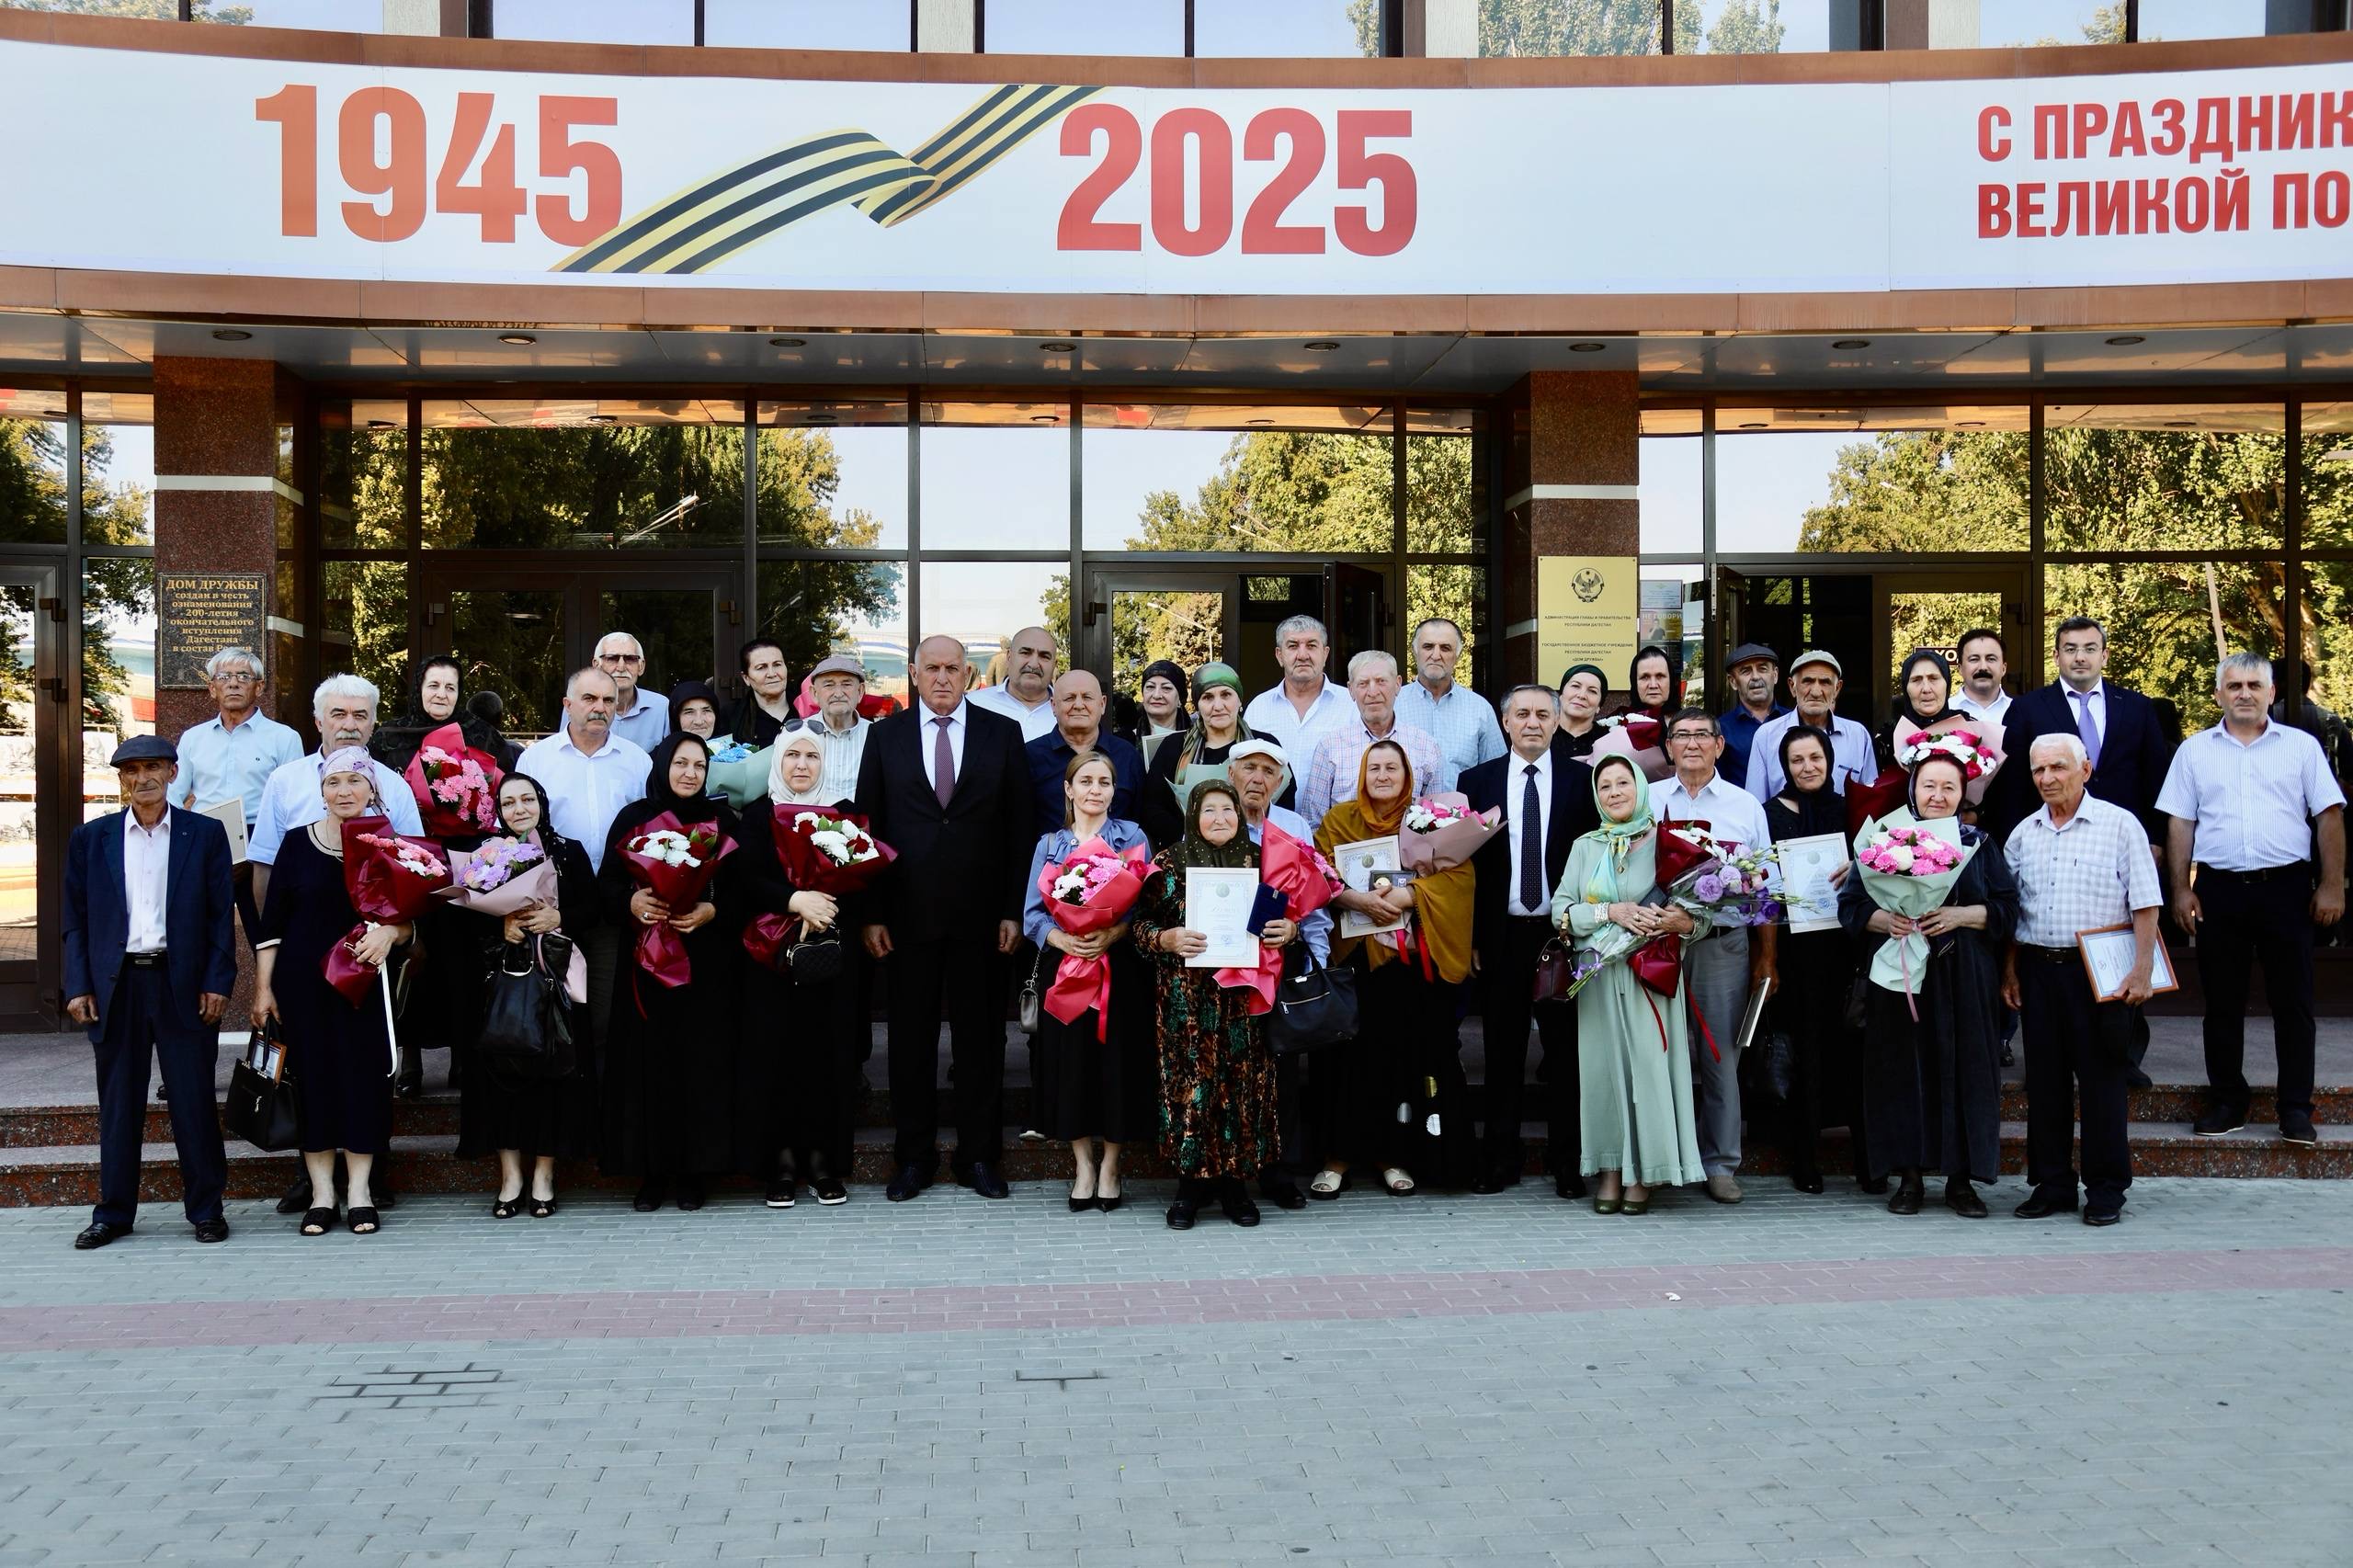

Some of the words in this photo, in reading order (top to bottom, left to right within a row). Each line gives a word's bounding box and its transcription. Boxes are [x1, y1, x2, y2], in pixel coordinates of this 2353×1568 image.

[1978, 106, 2012, 162] С
[2033, 90, 2353, 164] ПРАЗДНИК
[256, 84, 622, 247] 1945
[1057, 103, 1417, 256] 2025
[1978, 167, 2250, 238] ВЕЛИКОЙ
[2272, 171, 2351, 230] ПО
[165, 580, 196, 590] ДОМ
[199, 580, 258, 590] ДРУЖБЫ
[186, 608, 239, 617] 200-летия
[186, 635, 238, 643] Дагестана
